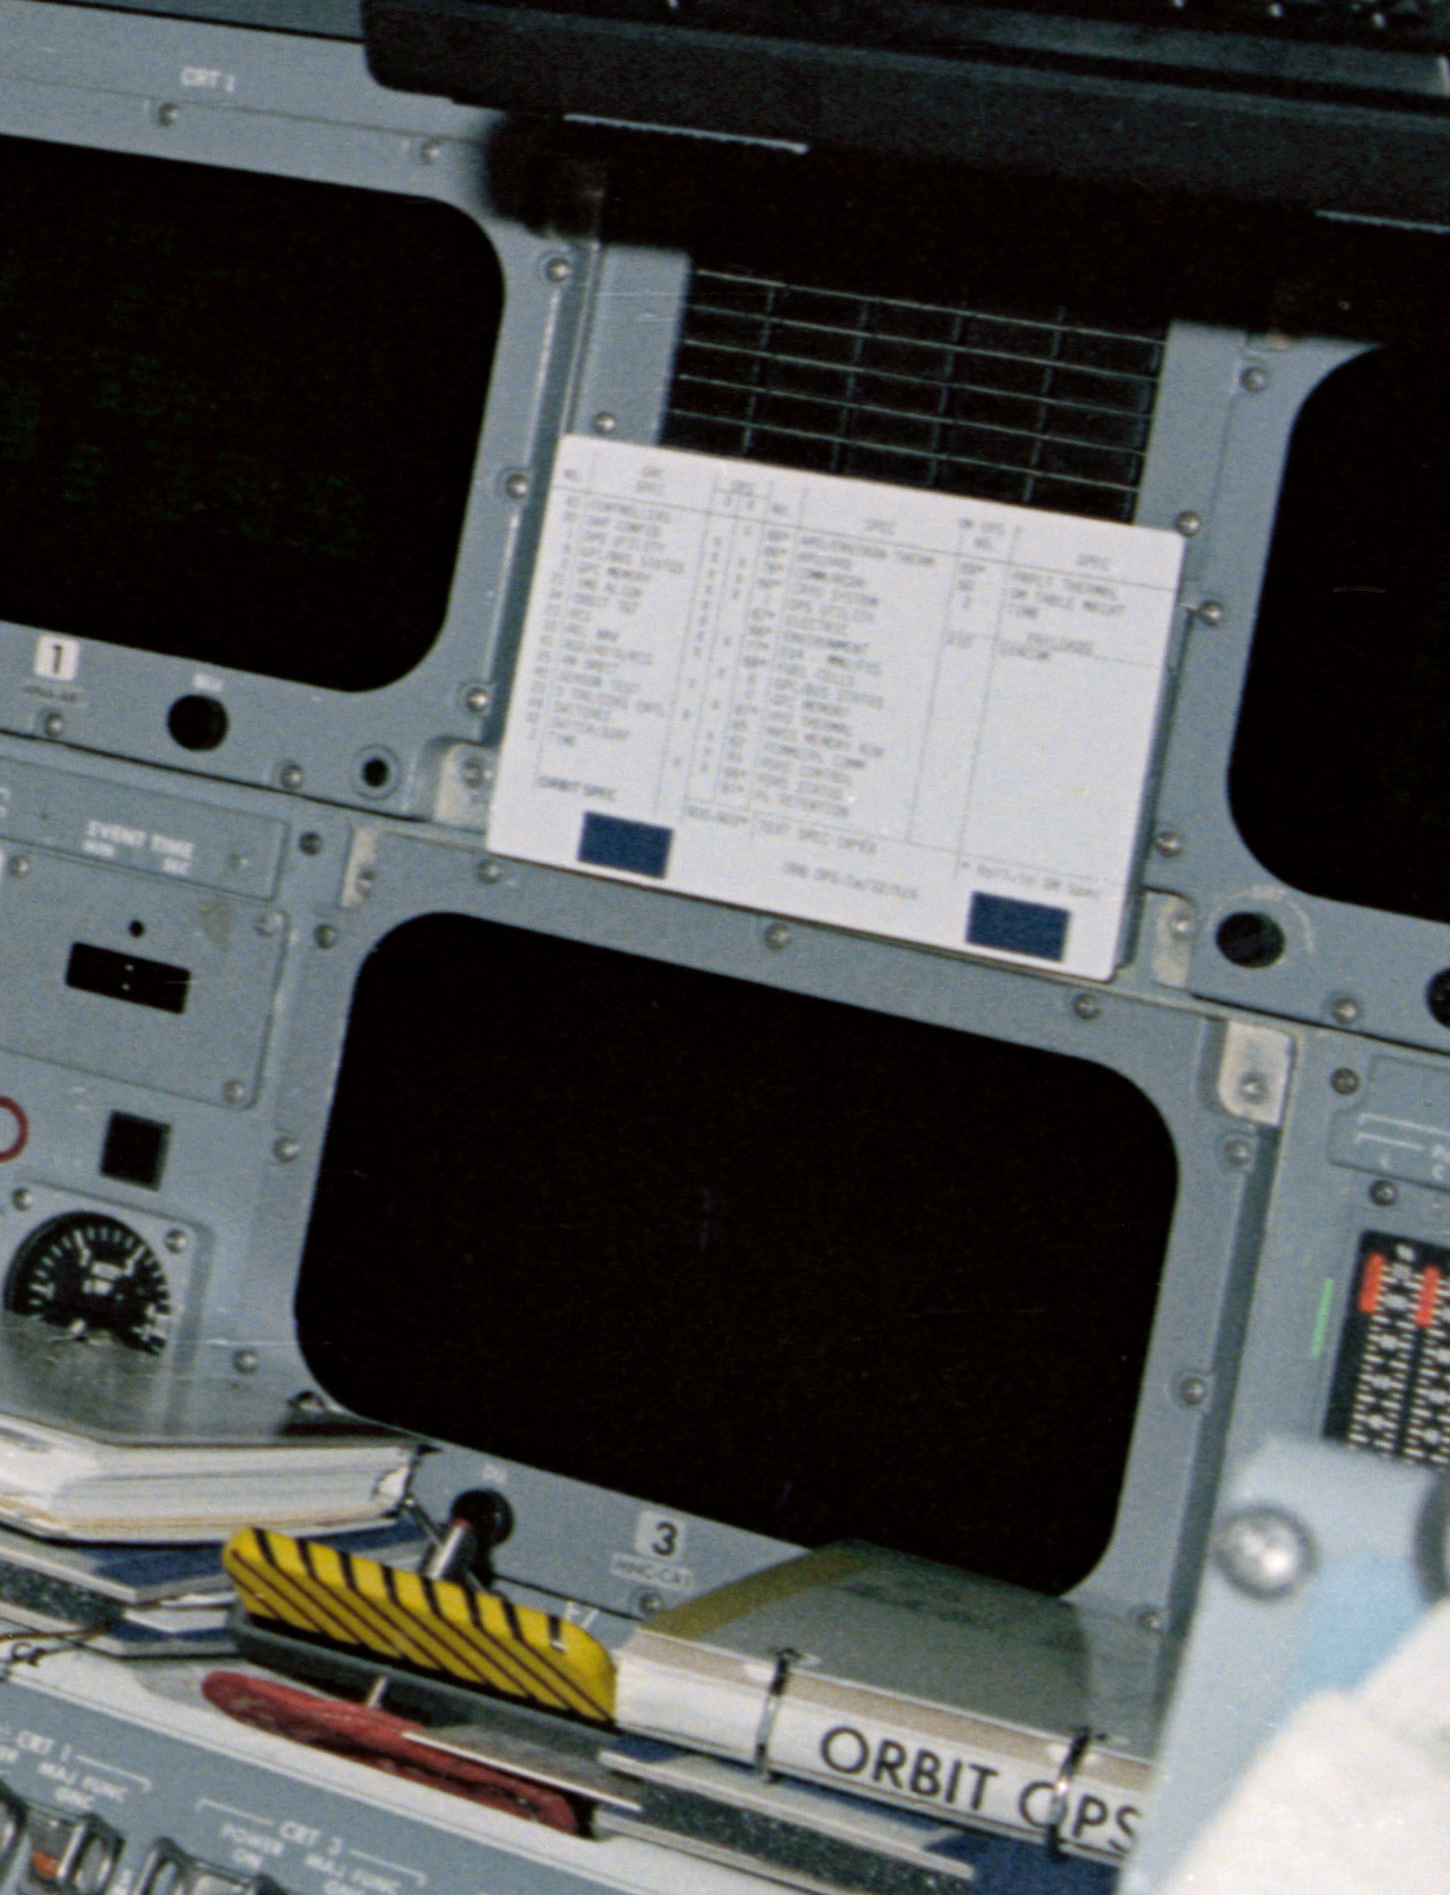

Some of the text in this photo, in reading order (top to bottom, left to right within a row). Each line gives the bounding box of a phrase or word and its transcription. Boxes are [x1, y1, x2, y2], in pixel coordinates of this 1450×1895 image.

[51, 644, 65, 675] 1
[87, 819, 195, 860] EVENT TIME
[652, 1521, 678, 1556] 3
[15, 1730, 55, 1755] CRT
[820, 1725, 1143, 1853] ORBIT OPS
[220, 1823, 285, 1857] POWER
[278, 1819, 322, 1847] CRT
